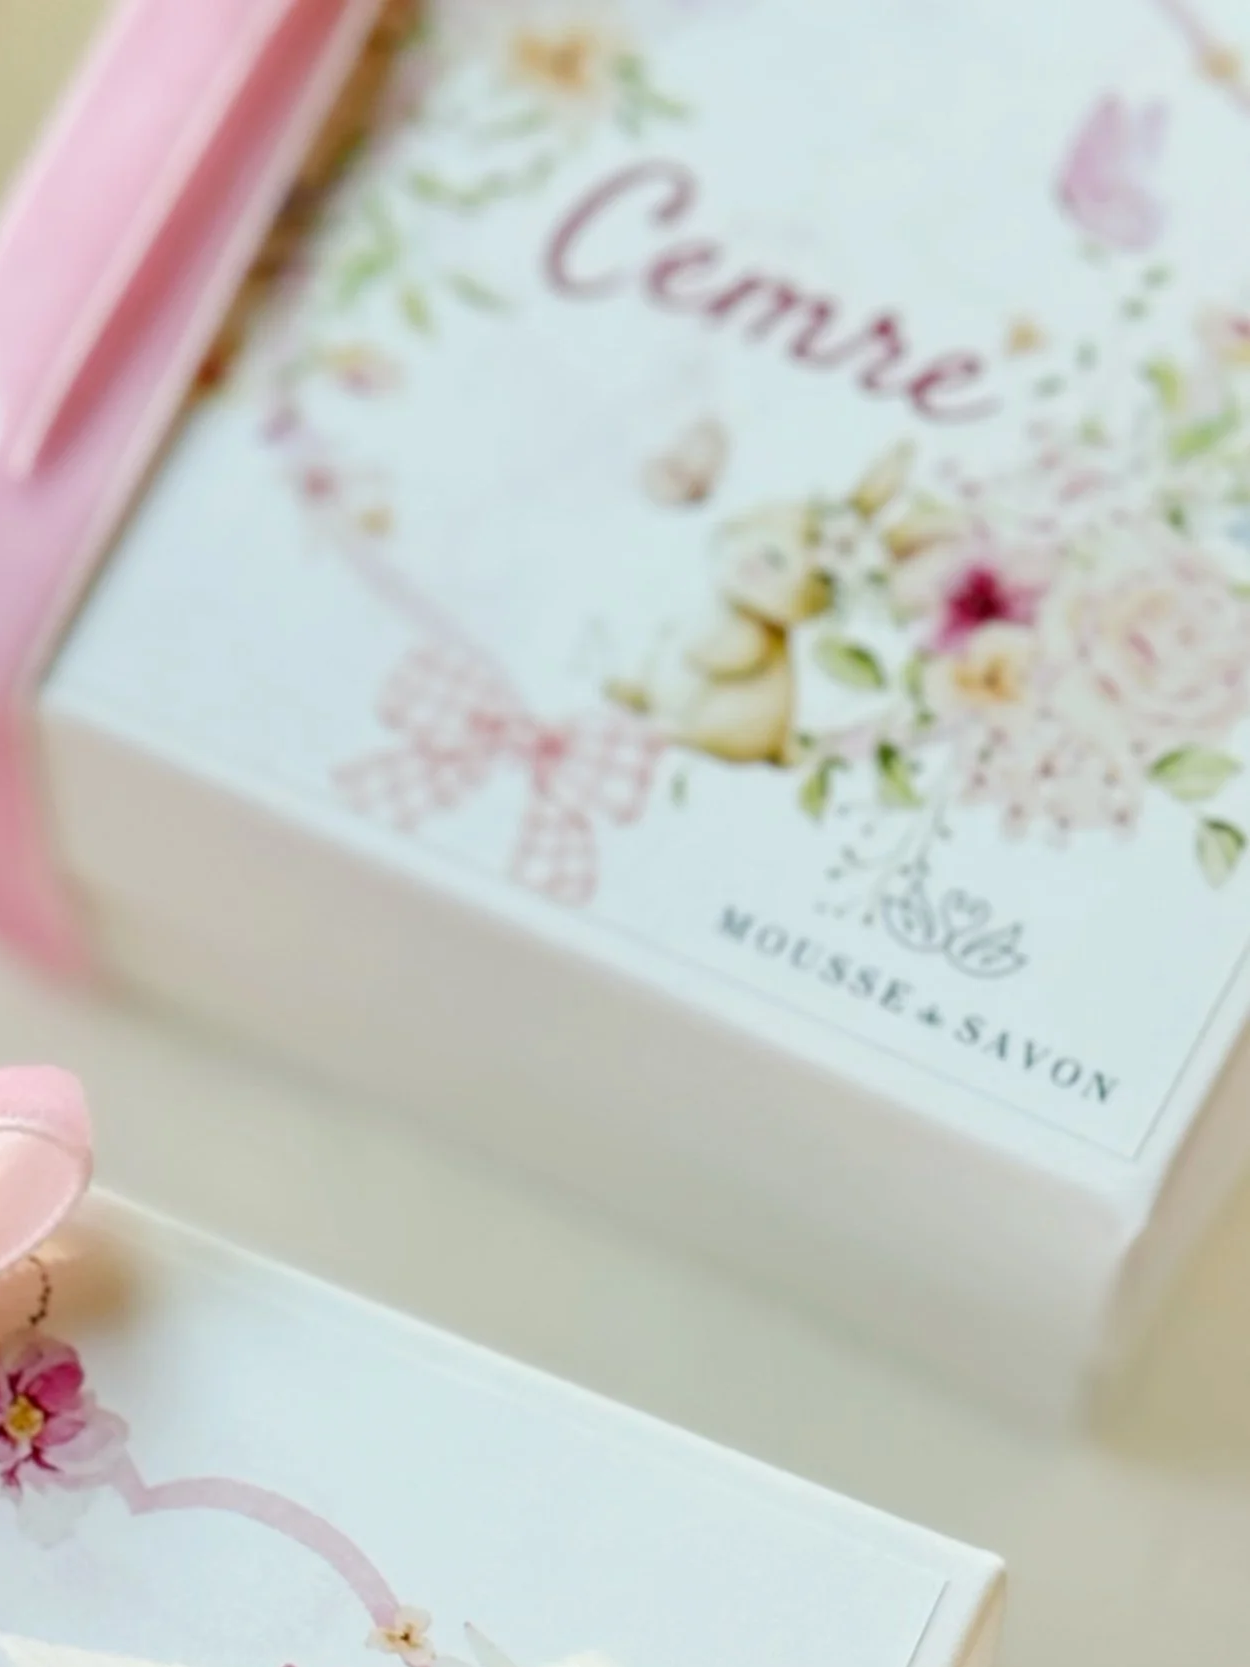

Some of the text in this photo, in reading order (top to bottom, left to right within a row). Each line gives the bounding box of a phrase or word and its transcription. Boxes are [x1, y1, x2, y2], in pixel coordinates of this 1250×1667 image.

[544, 159, 1002, 424] Cemre
[717, 906, 1119, 1104] MOUSSE SAVON
